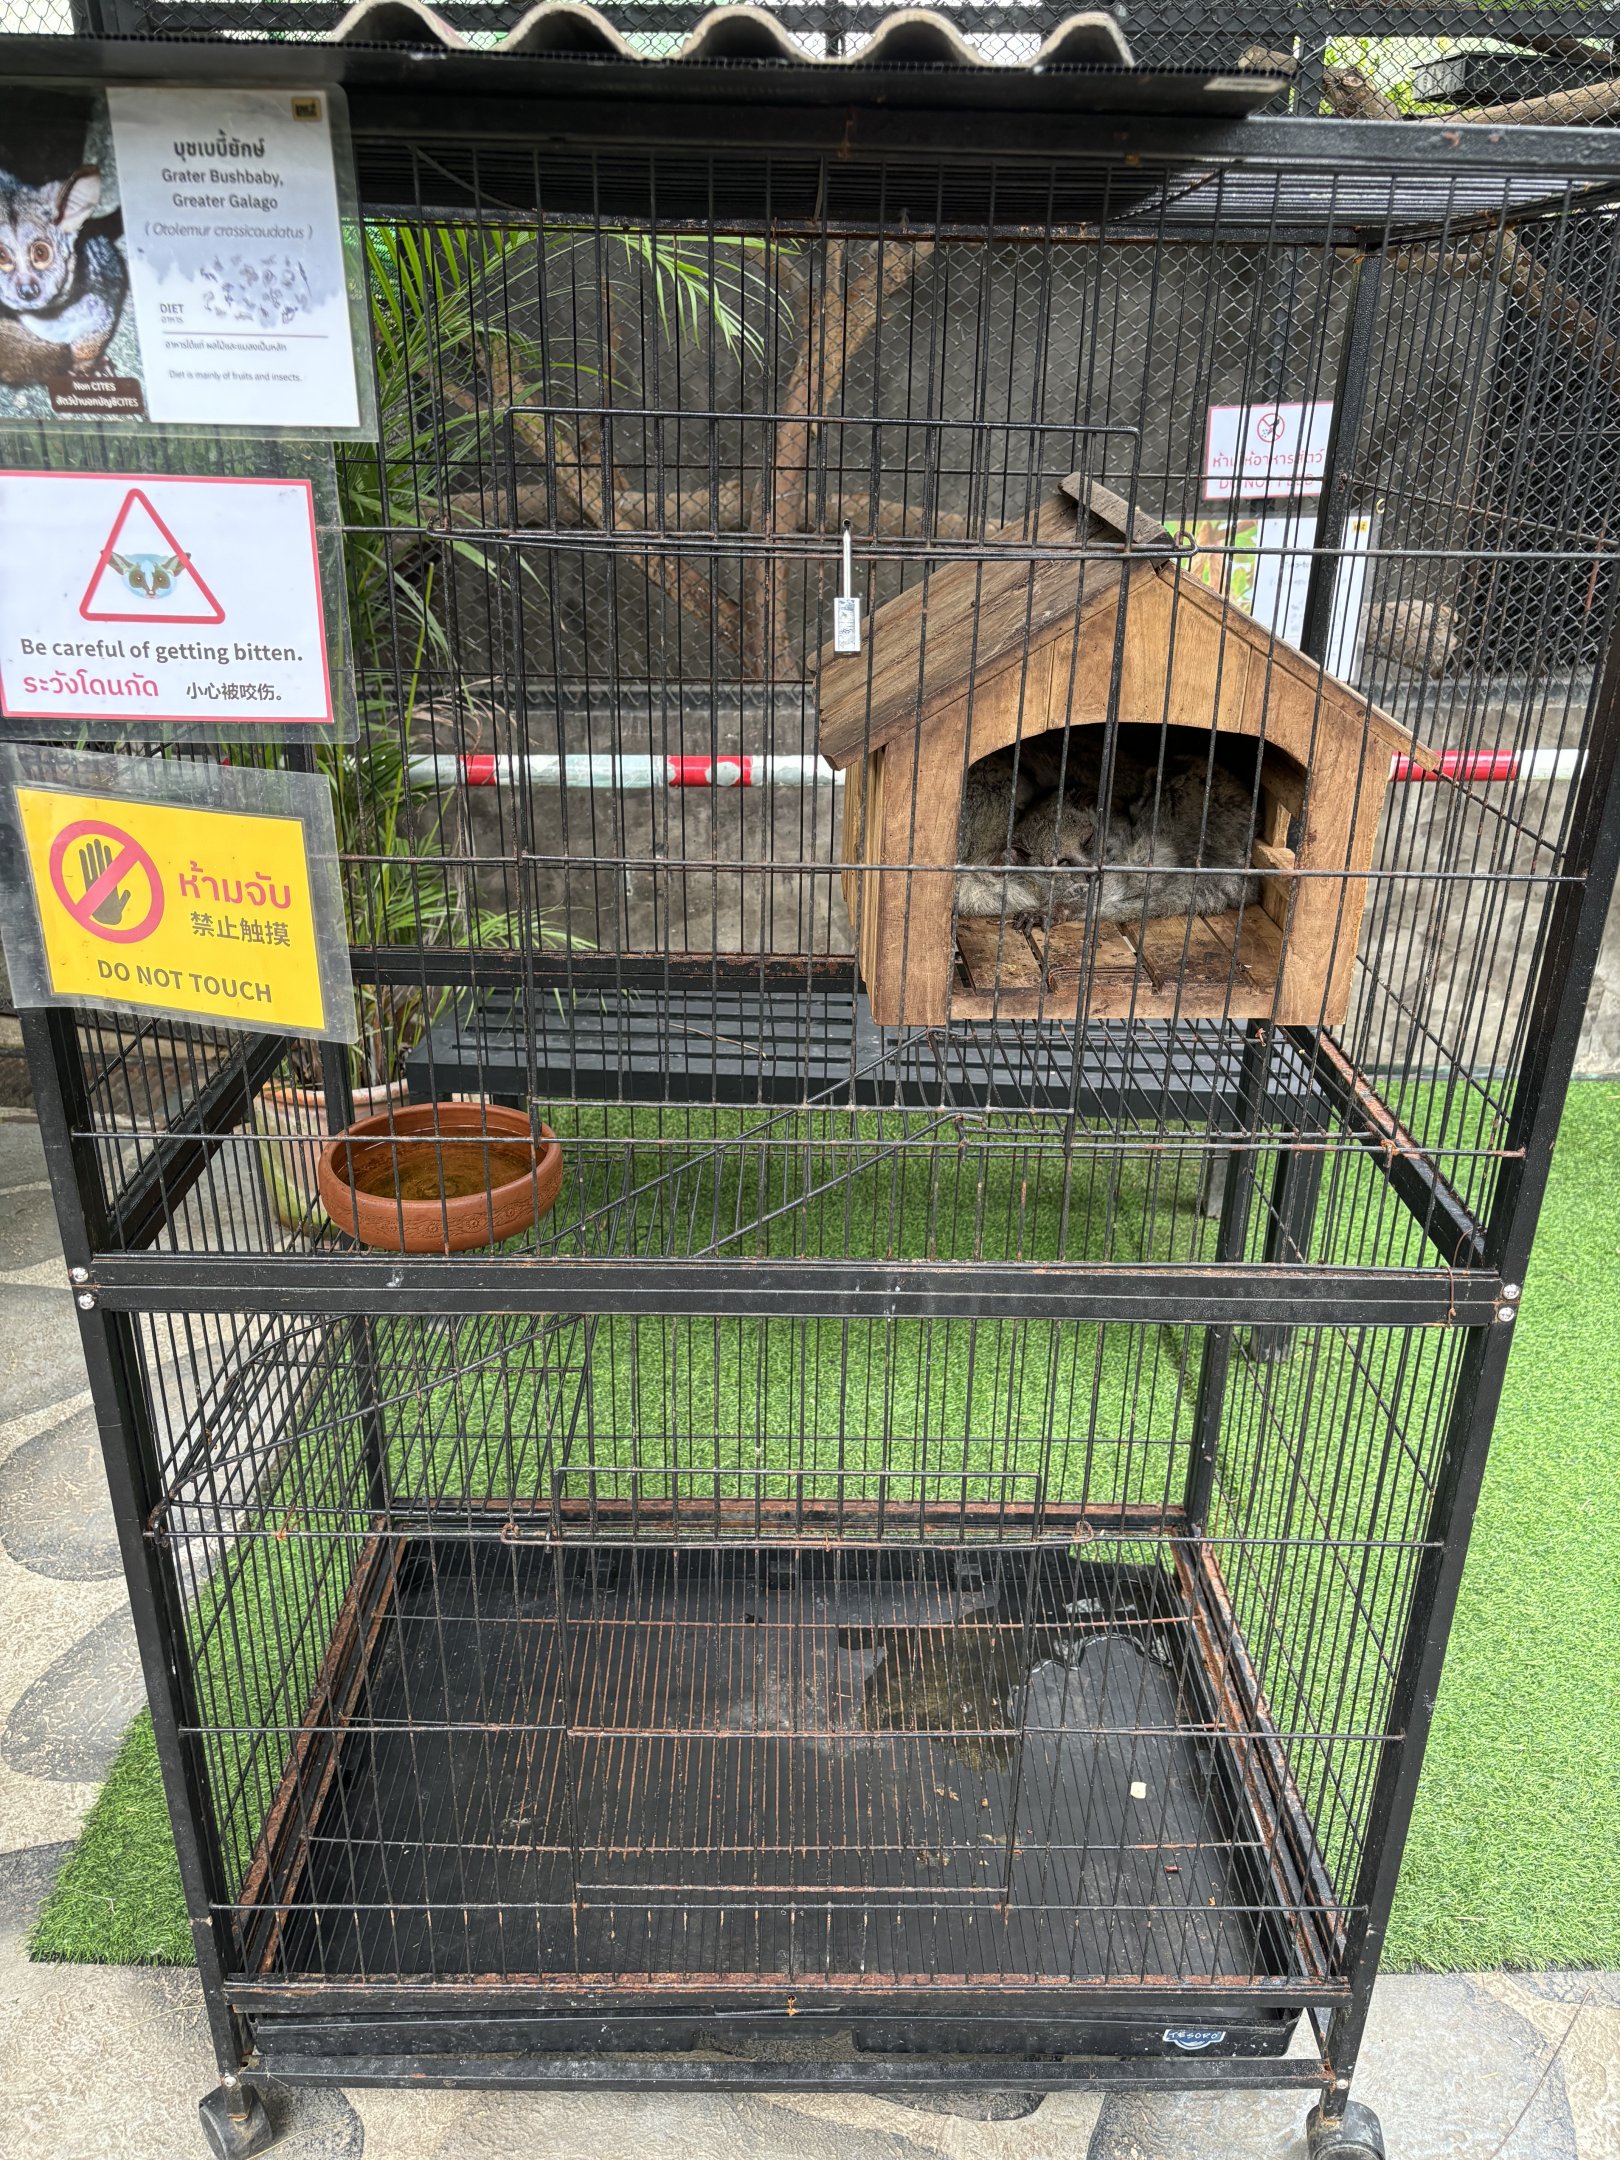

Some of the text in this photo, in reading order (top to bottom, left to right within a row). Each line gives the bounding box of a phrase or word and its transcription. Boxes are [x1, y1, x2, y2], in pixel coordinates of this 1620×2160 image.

[174, 129, 265, 162] บุชเบบี้ยักษ์
[162, 168, 283, 187] Grater Bushbaby,
[173, 194, 278, 212] Greater Galago
[153, 222, 211, 236] Otolemur
[214, 223, 304, 239] crassicaudatus
[160, 303, 184, 313] DIET
[169, 370, 185, 379] Diet
[195, 371, 220, 381] mainly
[232, 372, 253, 381] fruits
[255, 372, 270, 381] and
[272, 373, 302, 382] insects.
[72, 381, 117, 391] Non CITES
[21, 638, 303, 664] Be careful of getting bitten.
[23, 668, 159, 697] ระวังโดนกัด
[186, 682, 284, 701] 小心被咬伤。
[179, 860, 292, 909] ห้ามจับ
[190, 911, 291, 947] 禁止触摸
[97, 959, 272, 1003] DO NOT TOUCH
